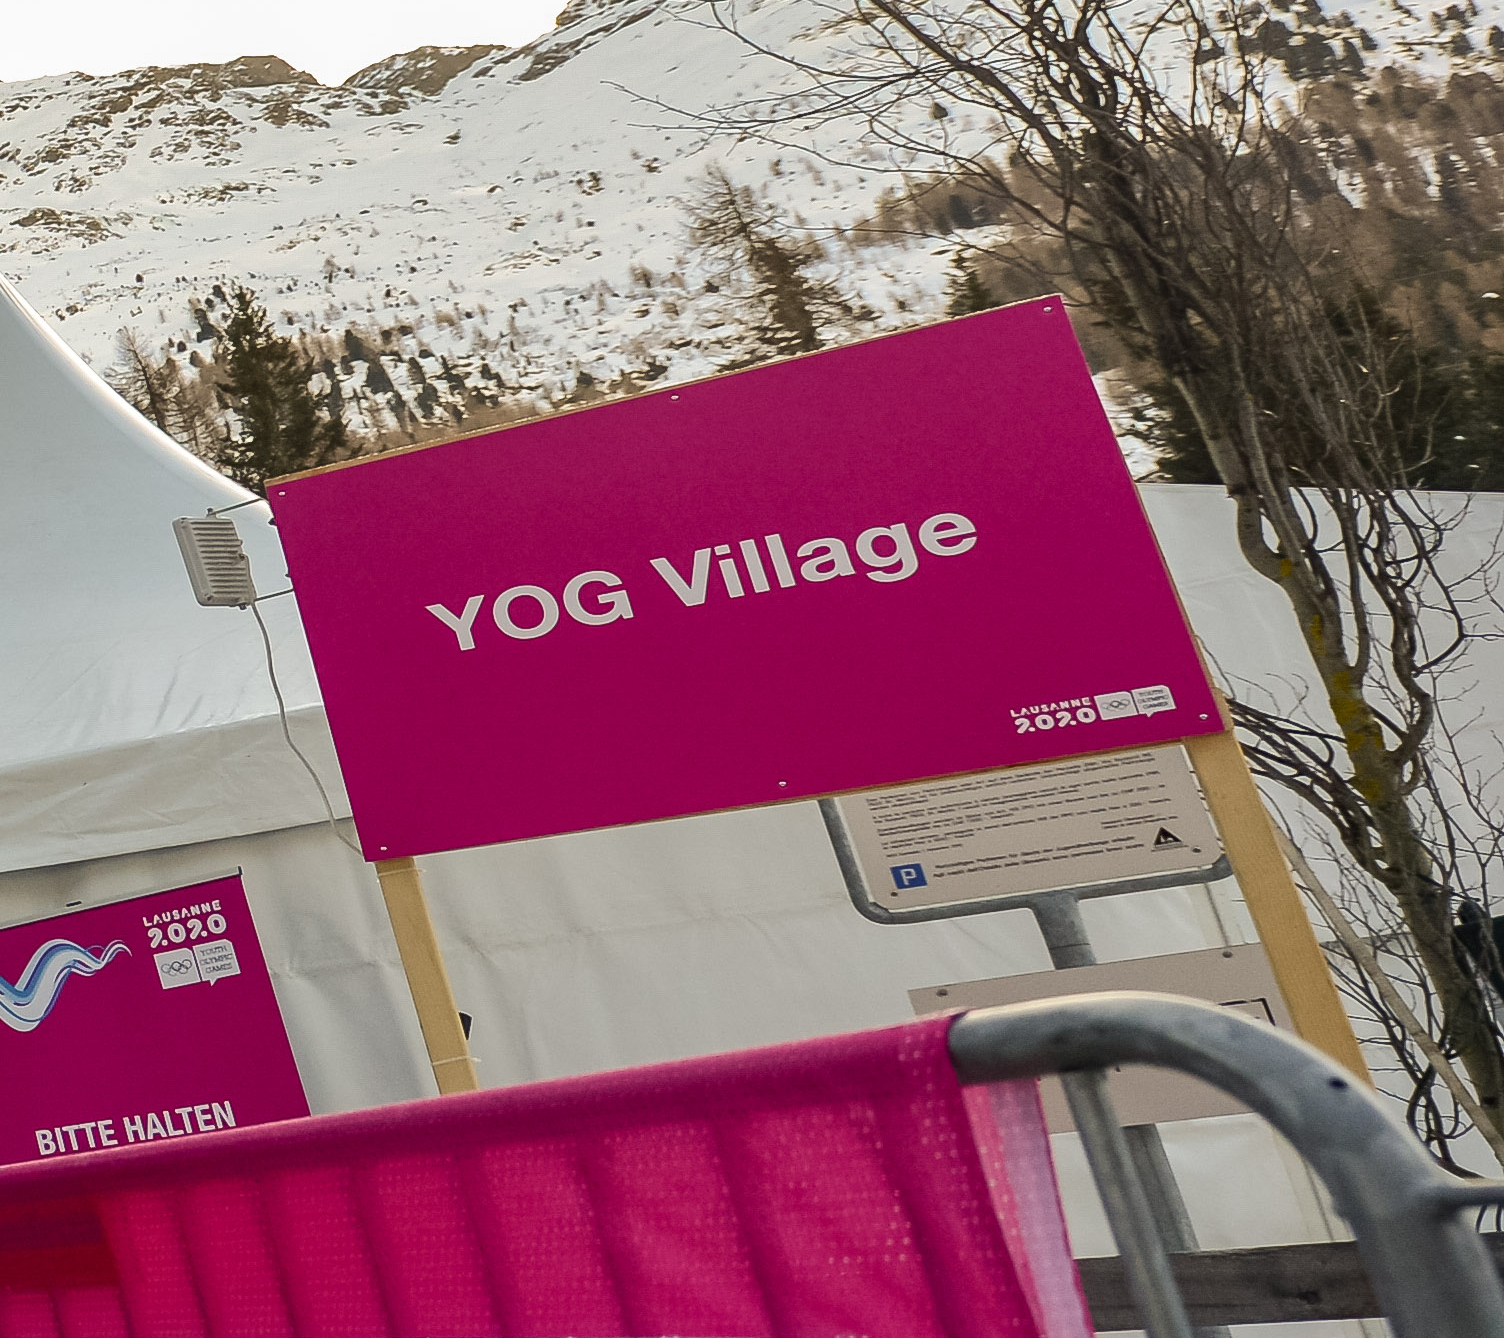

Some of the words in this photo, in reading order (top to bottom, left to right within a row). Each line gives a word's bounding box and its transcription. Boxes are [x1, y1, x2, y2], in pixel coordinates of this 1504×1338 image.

[425, 569, 634, 651] YOG
[649, 512, 977, 607] Village
[1010, 696, 1092, 718] LAUSANNE
[1014, 707, 1097, 734] 2020
[899, 867, 917, 886] P
[142, 900, 222, 927] LAUSANNE
[148, 913, 227, 949] 2020
[200, 945, 227, 957] YOUTH
[200, 953, 233, 965] OLYMPIC
[206, 963, 233, 974] GAMES
[35, 1119, 118, 1155] BITTE
[123, 1100, 237, 1143] HALTEN
